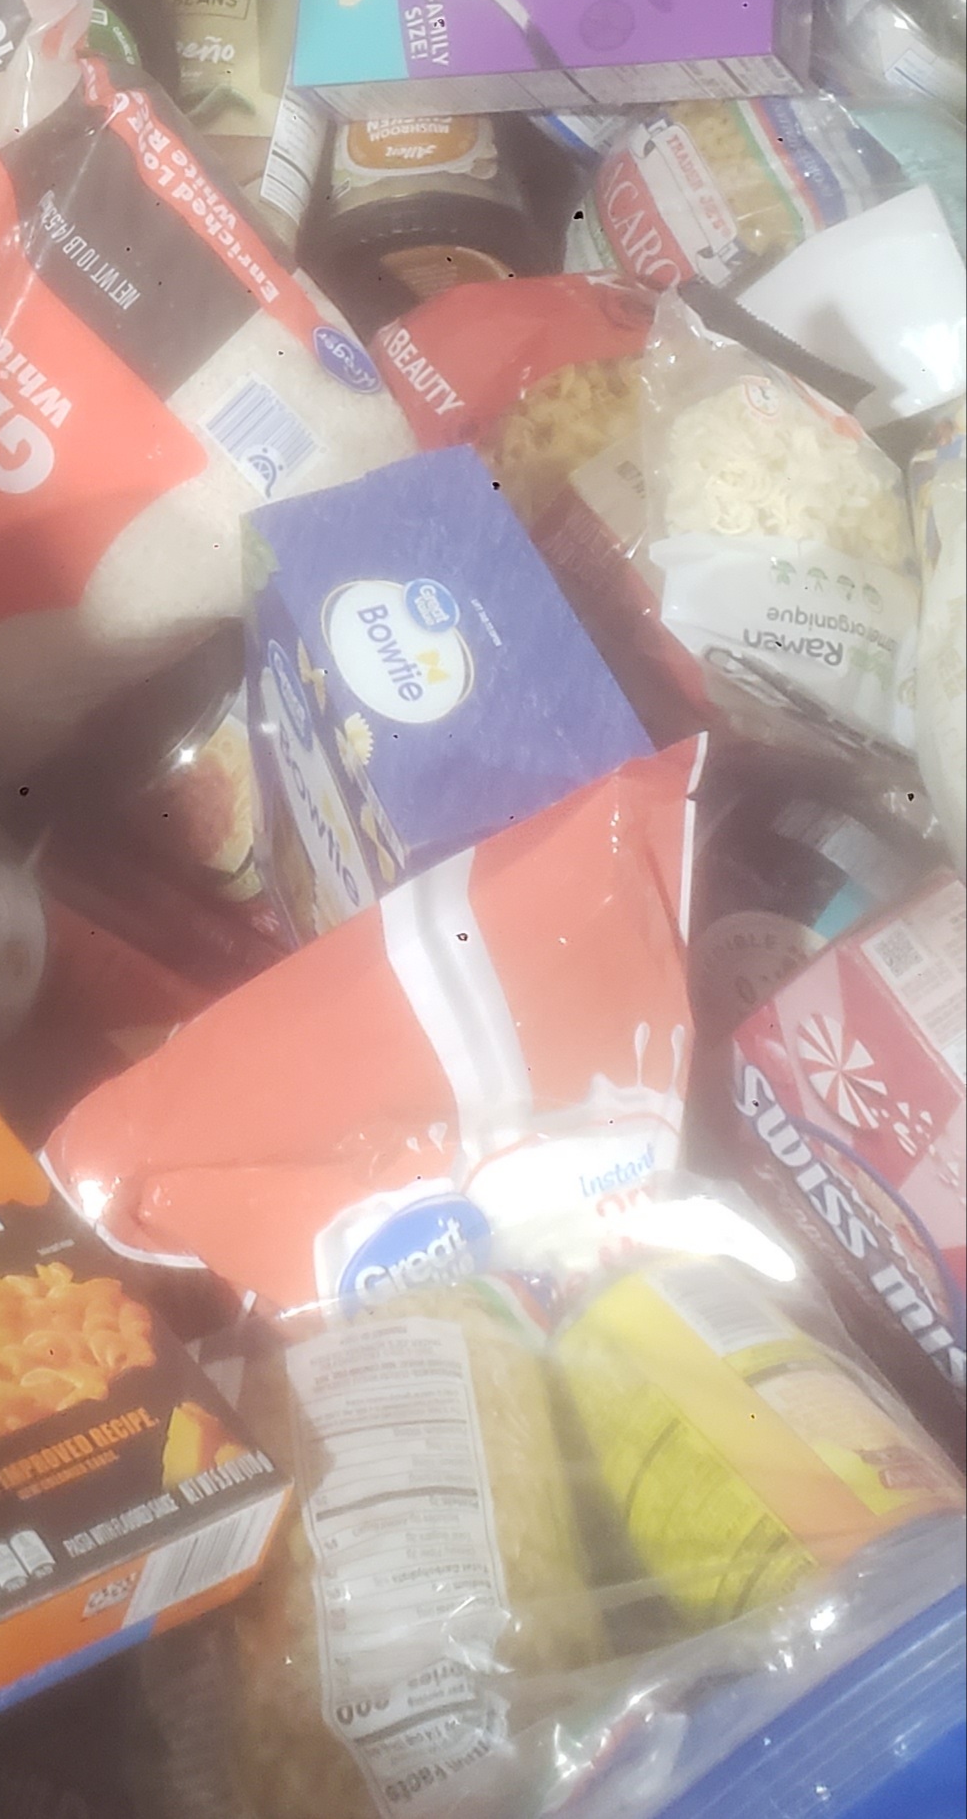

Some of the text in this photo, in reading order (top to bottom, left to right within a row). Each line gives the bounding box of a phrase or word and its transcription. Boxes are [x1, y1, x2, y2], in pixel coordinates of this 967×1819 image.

[404, 6, 428, 61] SIZE!
[368, 124, 450, 142] MUSHROOM
[666, 132, 705, 192] TRADER
[61, 234, 88, 256] LB
[75, 247, 101, 274] 10
[171, 181, 281, 305] Enriched
[90, 261, 129, 294] WT
[108, 278, 142, 311] NET
[386, 328, 466, 416] BEAUTY
[418, 584, 451, 625] Great
[766, 605, 867, 639] organique
[357, 604, 425, 703] Bowtie
[743, 628, 845, 667] Ramen
[578, 1141, 656, 1199] Instant
[353, 1214, 468, 1303] Great
